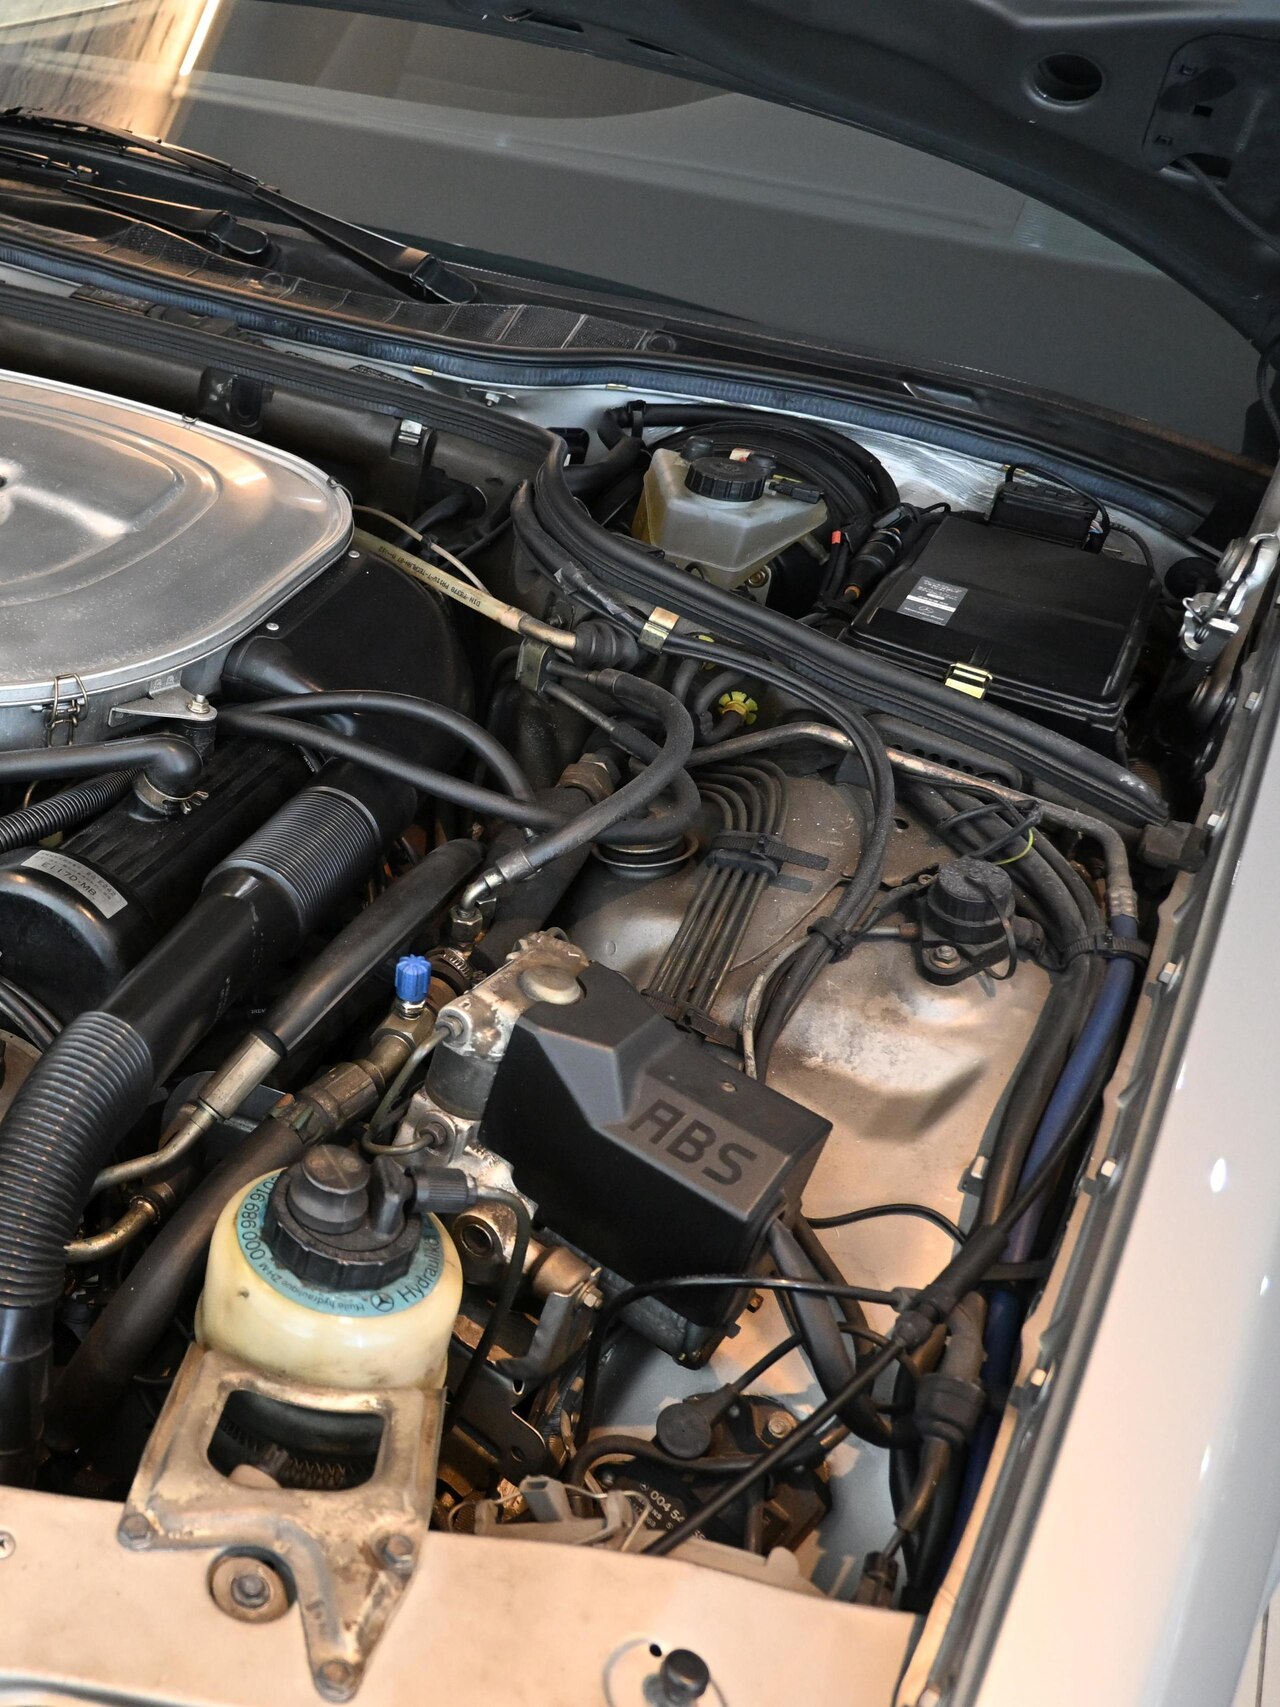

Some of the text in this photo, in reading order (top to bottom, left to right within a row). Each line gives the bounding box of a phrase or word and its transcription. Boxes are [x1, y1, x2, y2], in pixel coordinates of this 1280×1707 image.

[628, 1098, 758, 1185] ABS
[240, 1176, 279, 1261] 000 989 910
[650, 1490, 672, 1512] 004
